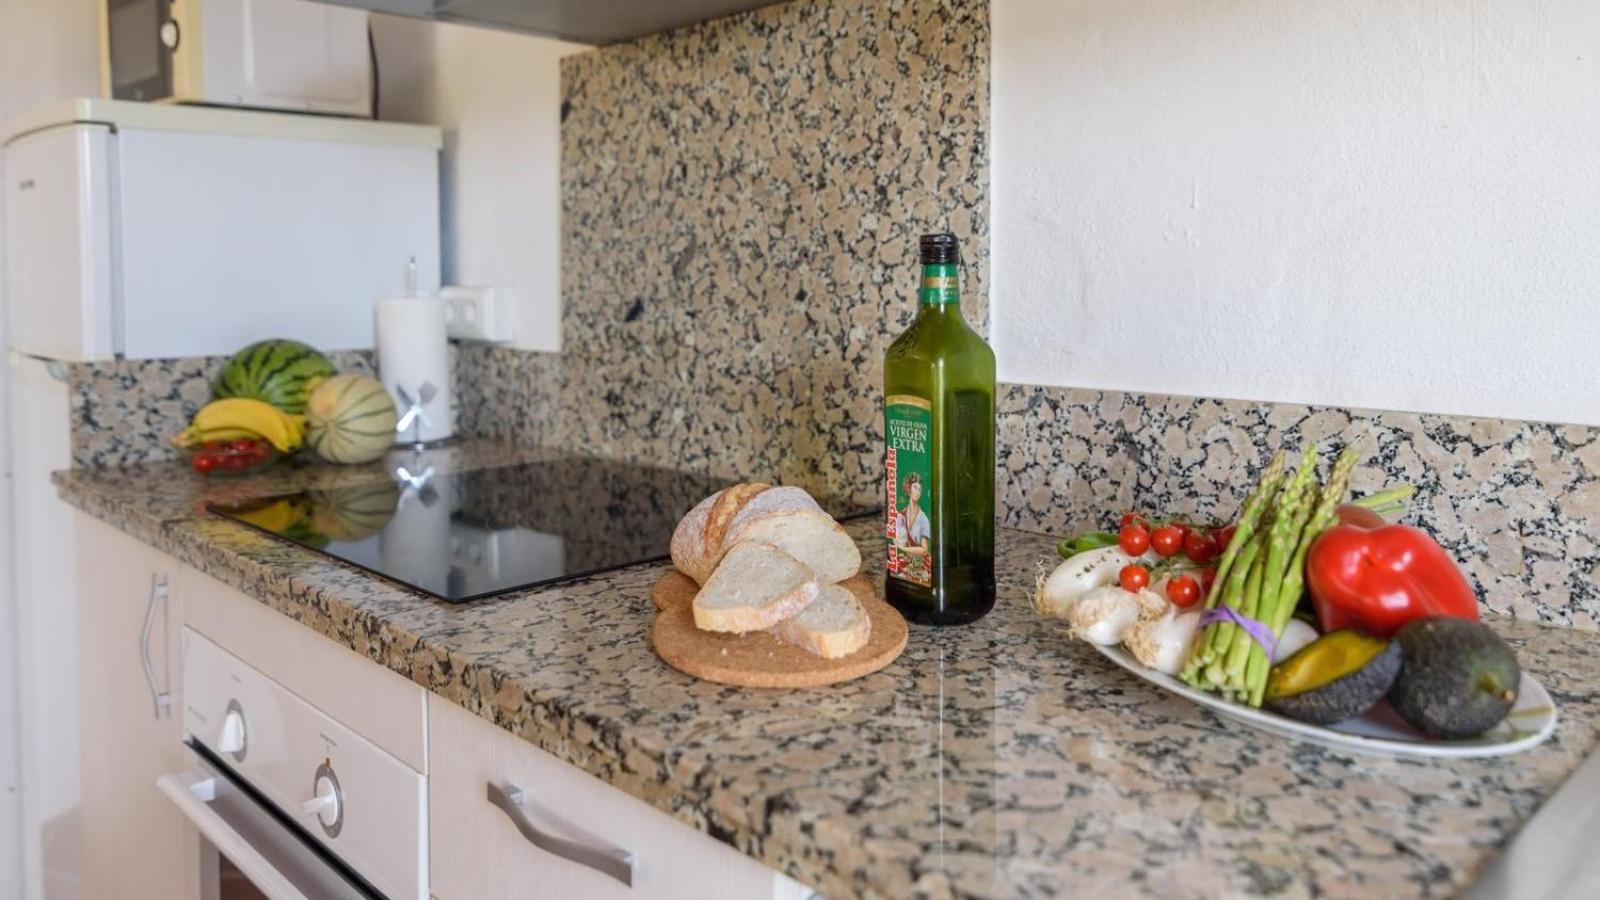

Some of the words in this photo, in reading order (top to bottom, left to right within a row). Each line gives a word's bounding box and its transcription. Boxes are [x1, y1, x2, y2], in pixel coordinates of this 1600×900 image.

[890, 425, 927, 441] VIRGEN
[893, 437, 926, 454] EXTRA
[887, 544, 898, 573] La
